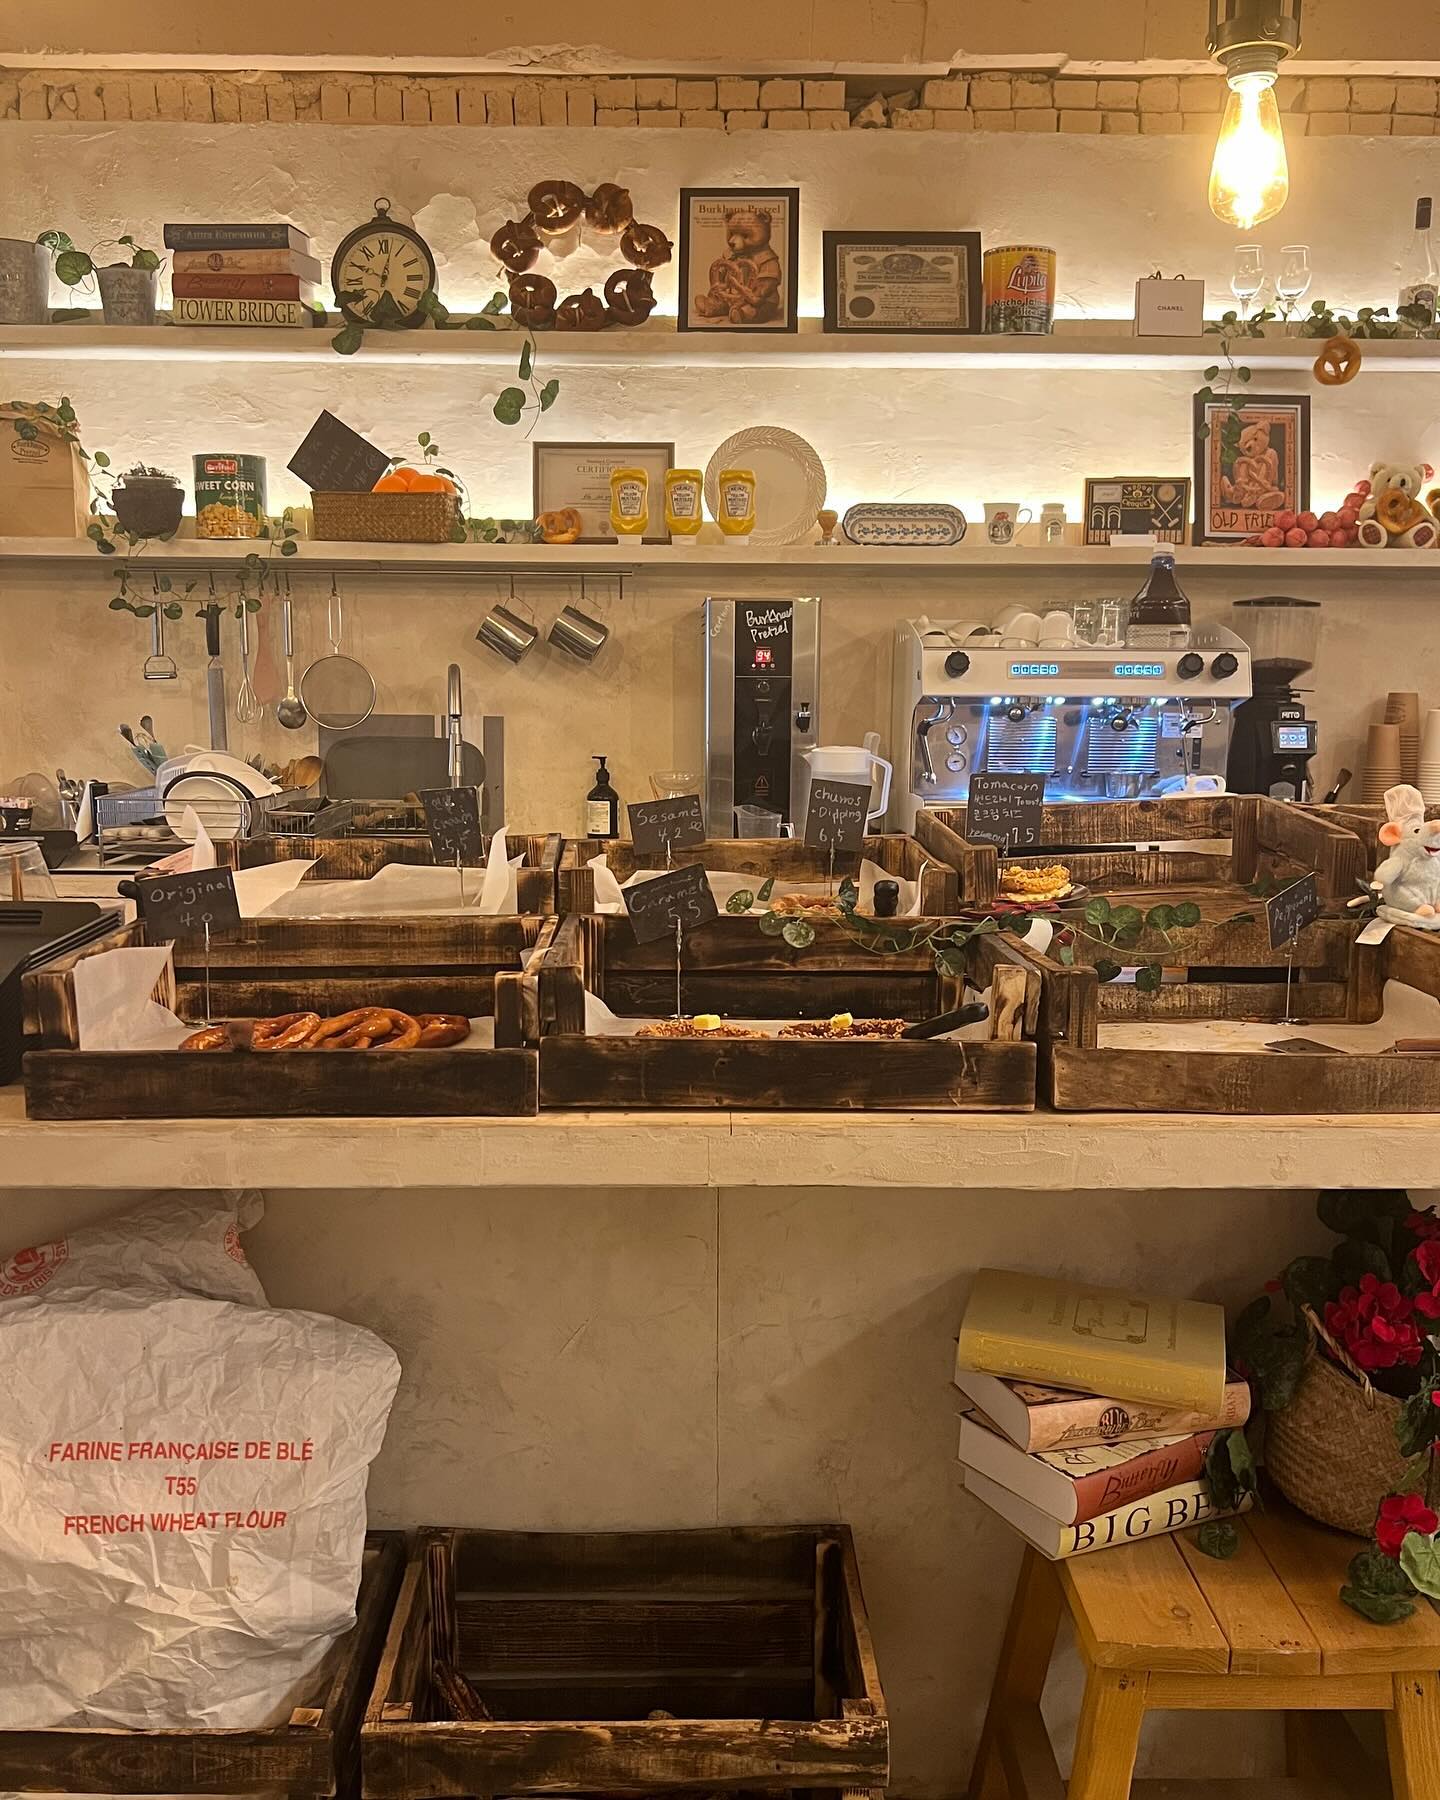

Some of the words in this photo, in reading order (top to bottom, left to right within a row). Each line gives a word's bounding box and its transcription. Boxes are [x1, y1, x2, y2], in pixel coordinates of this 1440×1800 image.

[698, 204, 744, 214] Burkhaus
[747, 204, 781, 214] Pretzel
[177, 299, 234, 321] TOWER
[238, 301, 297, 324] BRIDGE
[224, 480, 255, 492] CORN
[1212, 511, 1239, 530] OLD
[1244, 511, 1275, 531] FRIE
[750, 620, 789, 643] Pretzel
[150, 874, 232, 905] Original
[180, 912, 213, 928] 4.0
[49, 1441, 123, 1462] FARINE
[127, 1441, 240, 1465] FRANÇAISE
[243, 1441, 272, 1460] DE
[275, 1437, 314, 1462] BLÉ
[164, 1476, 197, 1496] T55
[1098, 1457, 1179, 1506] Butterfly
[63, 1513, 145, 1536] FRENCH
[150, 1511, 219, 1533] WHEAT
[224, 1510, 287, 1529] FLOUR
[1070, 1505, 1152, 1553] BIG
